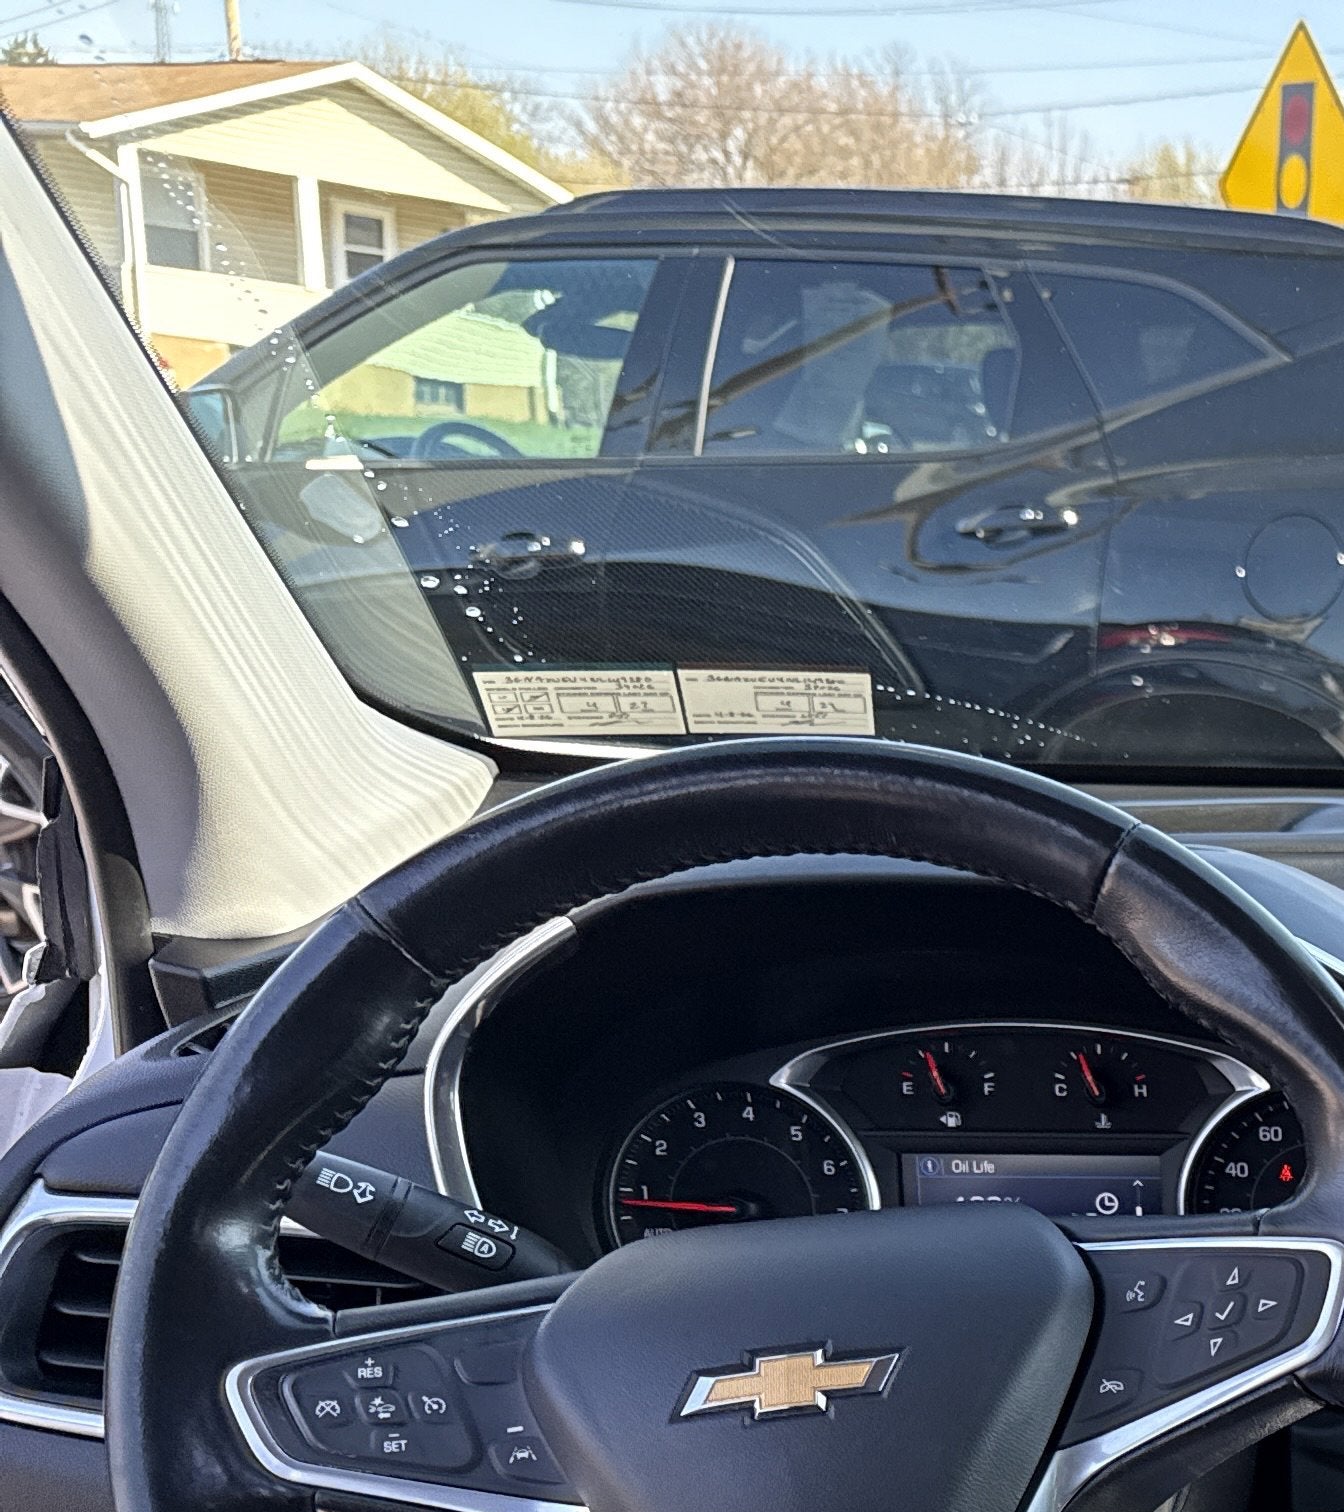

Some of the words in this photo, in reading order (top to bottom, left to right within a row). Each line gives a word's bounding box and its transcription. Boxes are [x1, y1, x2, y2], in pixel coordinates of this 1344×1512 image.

[902, 1081, 915, 1096] E
[983, 1082, 995, 1096] F
[1054, 1083, 1068, 1097] C
[1133, 1084, 1148, 1098] H
[693, 1111, 706, 1128] 3
[742, 1106, 755, 1122] 4
[790, 1125, 803, 1141] 5
[1258, 1126, 1282, 1142] 60
[655, 1140, 668, 1155] 2
[823, 1159, 836, 1175] 6
[951, 1159, 970, 1174] Oil
[972, 1159, 995, 1174] Life
[1224, 1162, 1249, 1178] 40
[641, 1185, 649, 1200] 1
[357, 1365, 383, 1379] RES
[383, 1438, 408, 1453] SET
